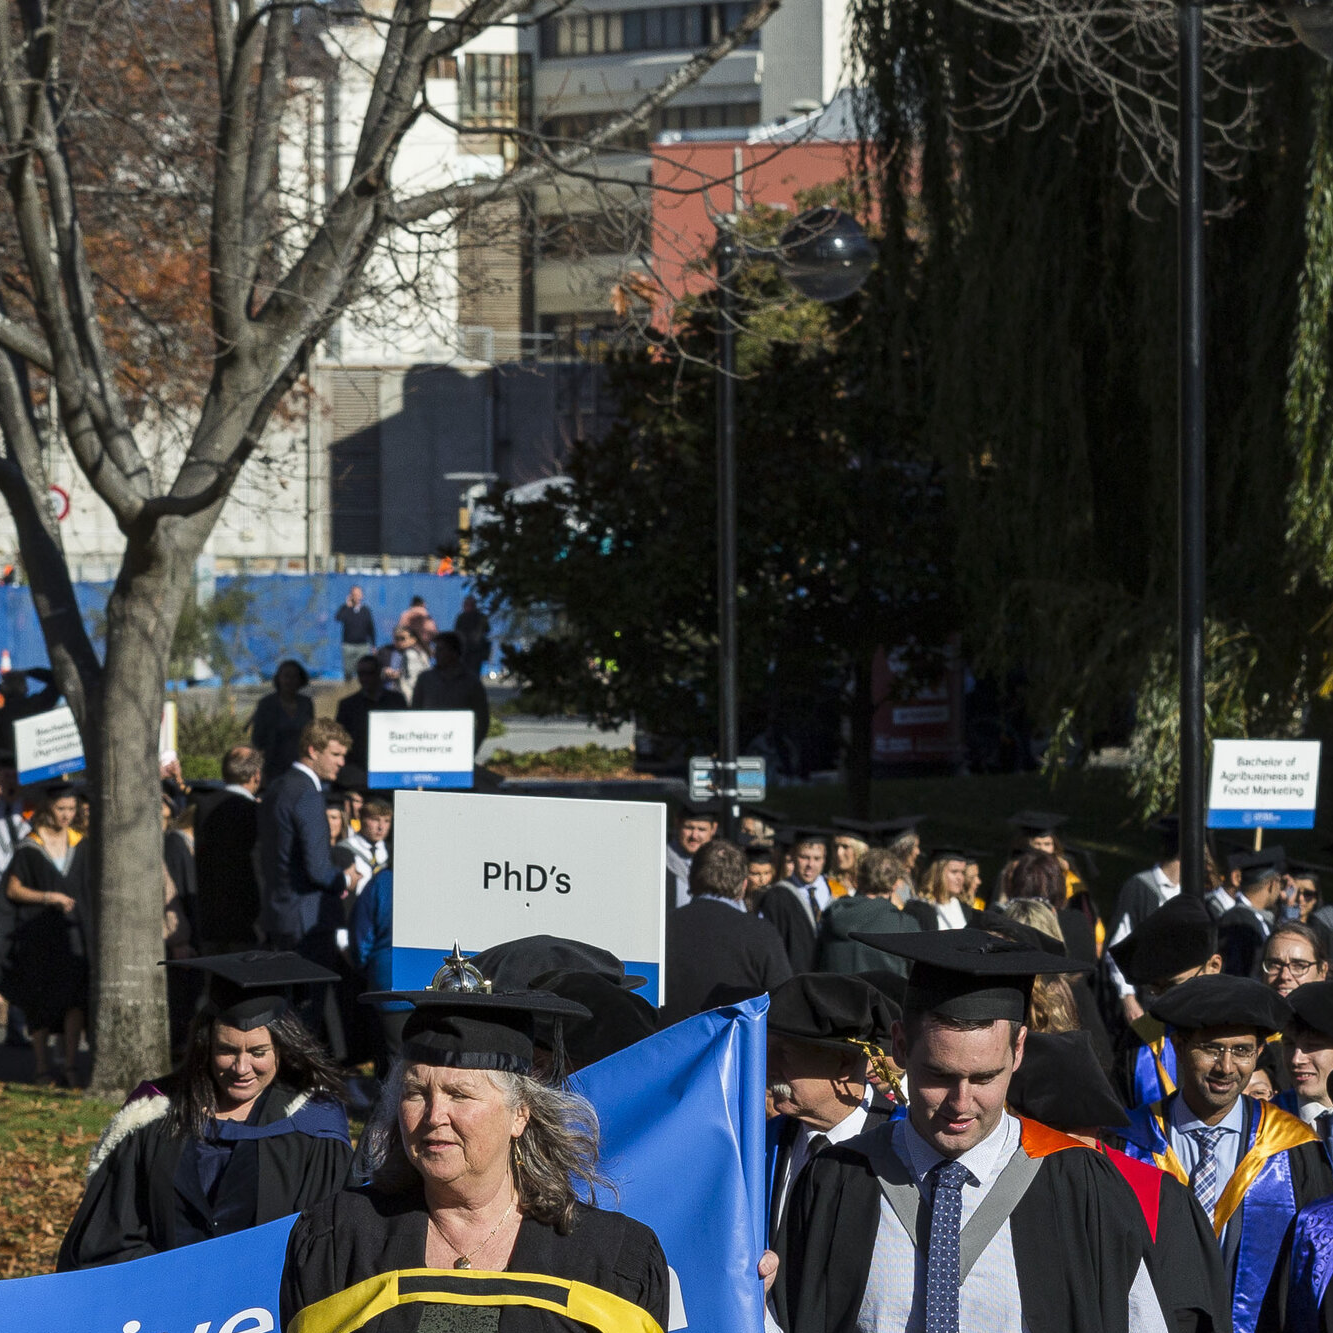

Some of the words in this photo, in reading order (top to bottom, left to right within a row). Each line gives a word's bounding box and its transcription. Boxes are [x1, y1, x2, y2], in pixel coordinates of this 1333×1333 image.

[389, 731, 438, 740] Bachelor
[442, 731, 453, 740] of
[389, 744, 453, 753] Commerce
[1237, 756, 1282, 767] Bachelor
[1285, 757, 1296, 767] of
[1221, 771, 1288, 782] Agribusiness
[1290, 771, 1310, 781] and
[1223, 784, 1249, 795] Food
[1252, 786, 1304, 797] Marketing
